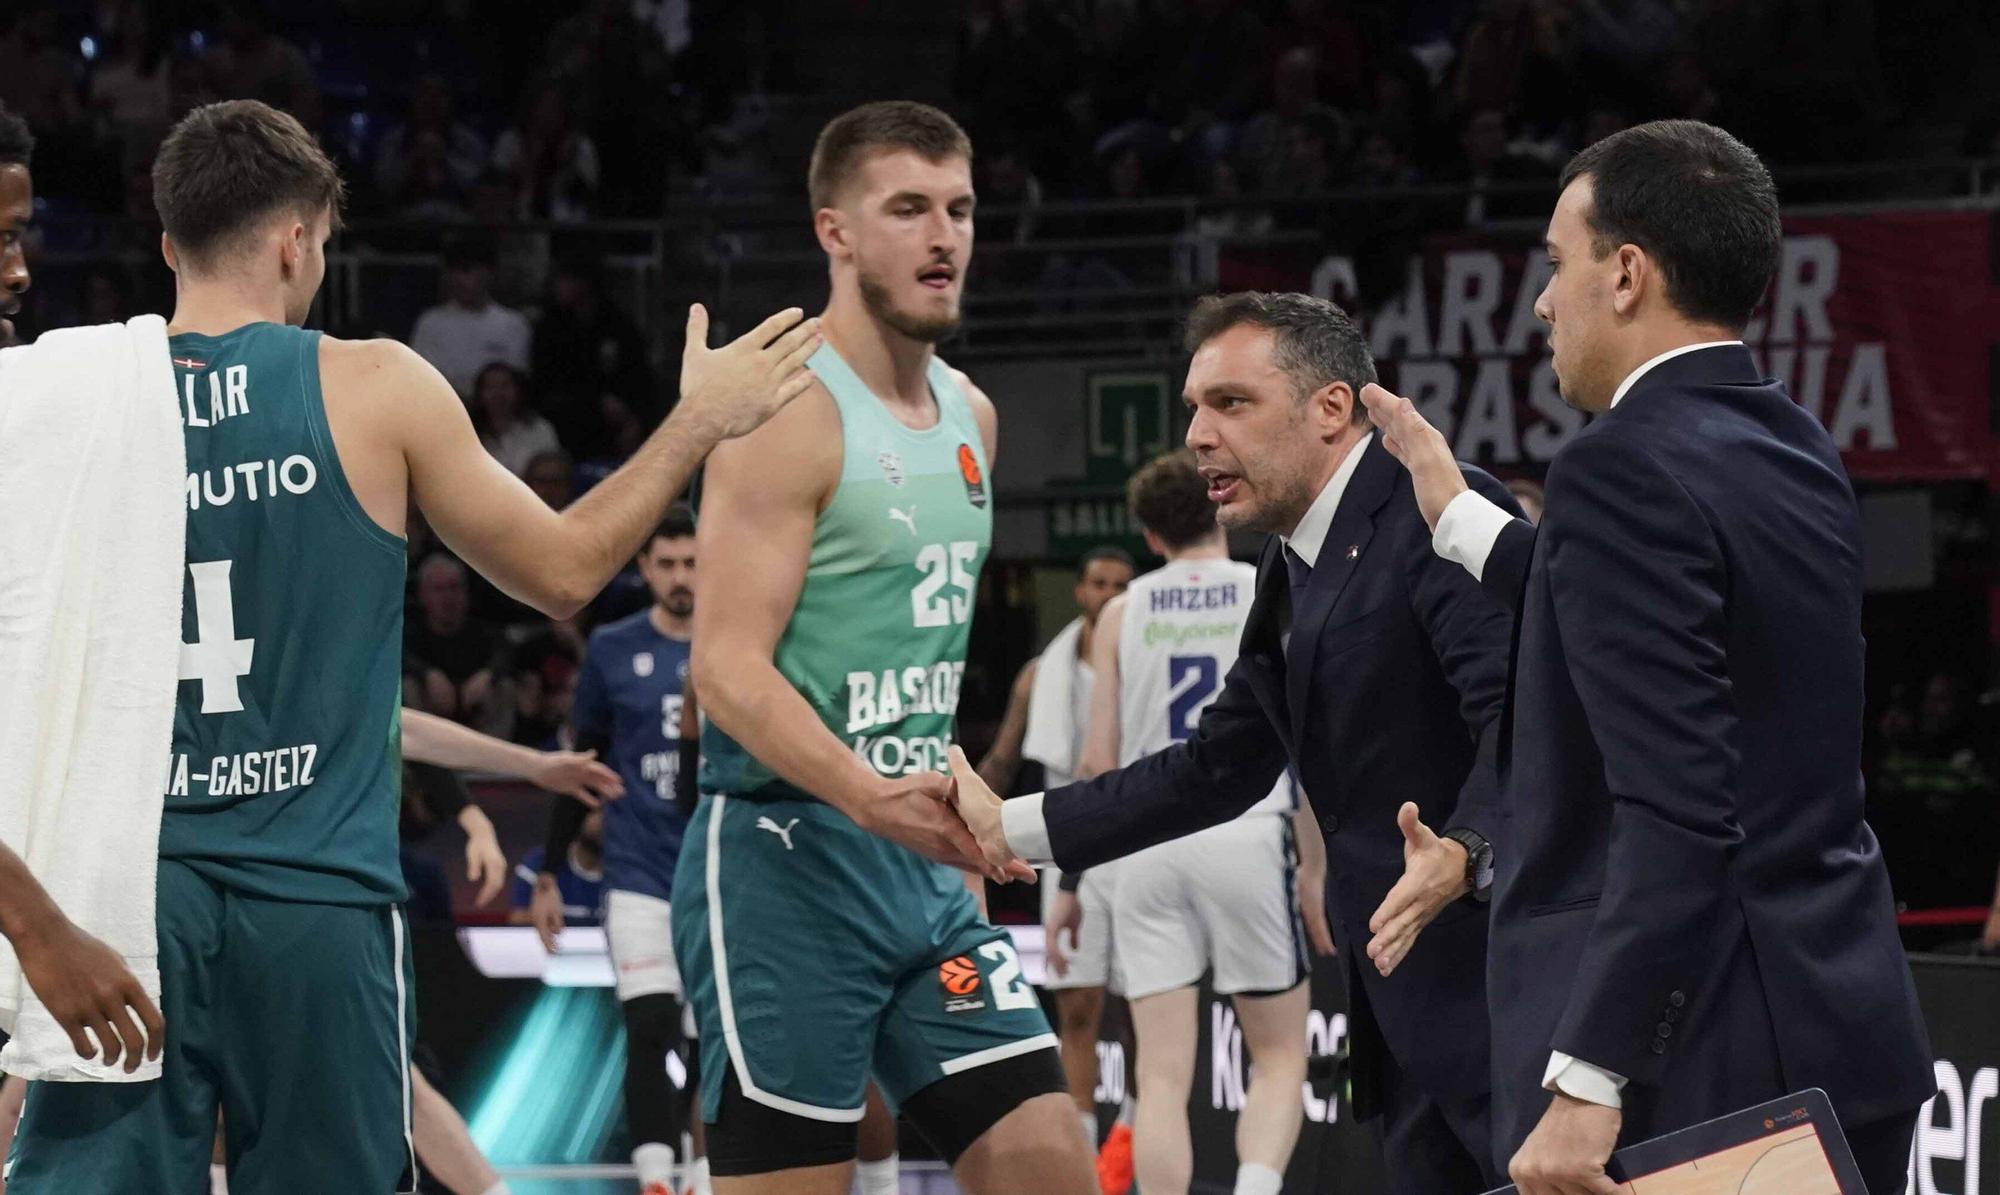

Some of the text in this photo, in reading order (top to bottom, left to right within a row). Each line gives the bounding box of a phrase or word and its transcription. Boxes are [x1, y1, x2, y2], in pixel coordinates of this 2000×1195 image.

[183, 364, 250, 427] LAR
[911, 541, 979, 628] 25
[1150, 584, 1237, 613] HAZER
[1169, 656, 1218, 740] 2
[977, 939, 1038, 1011] 2
